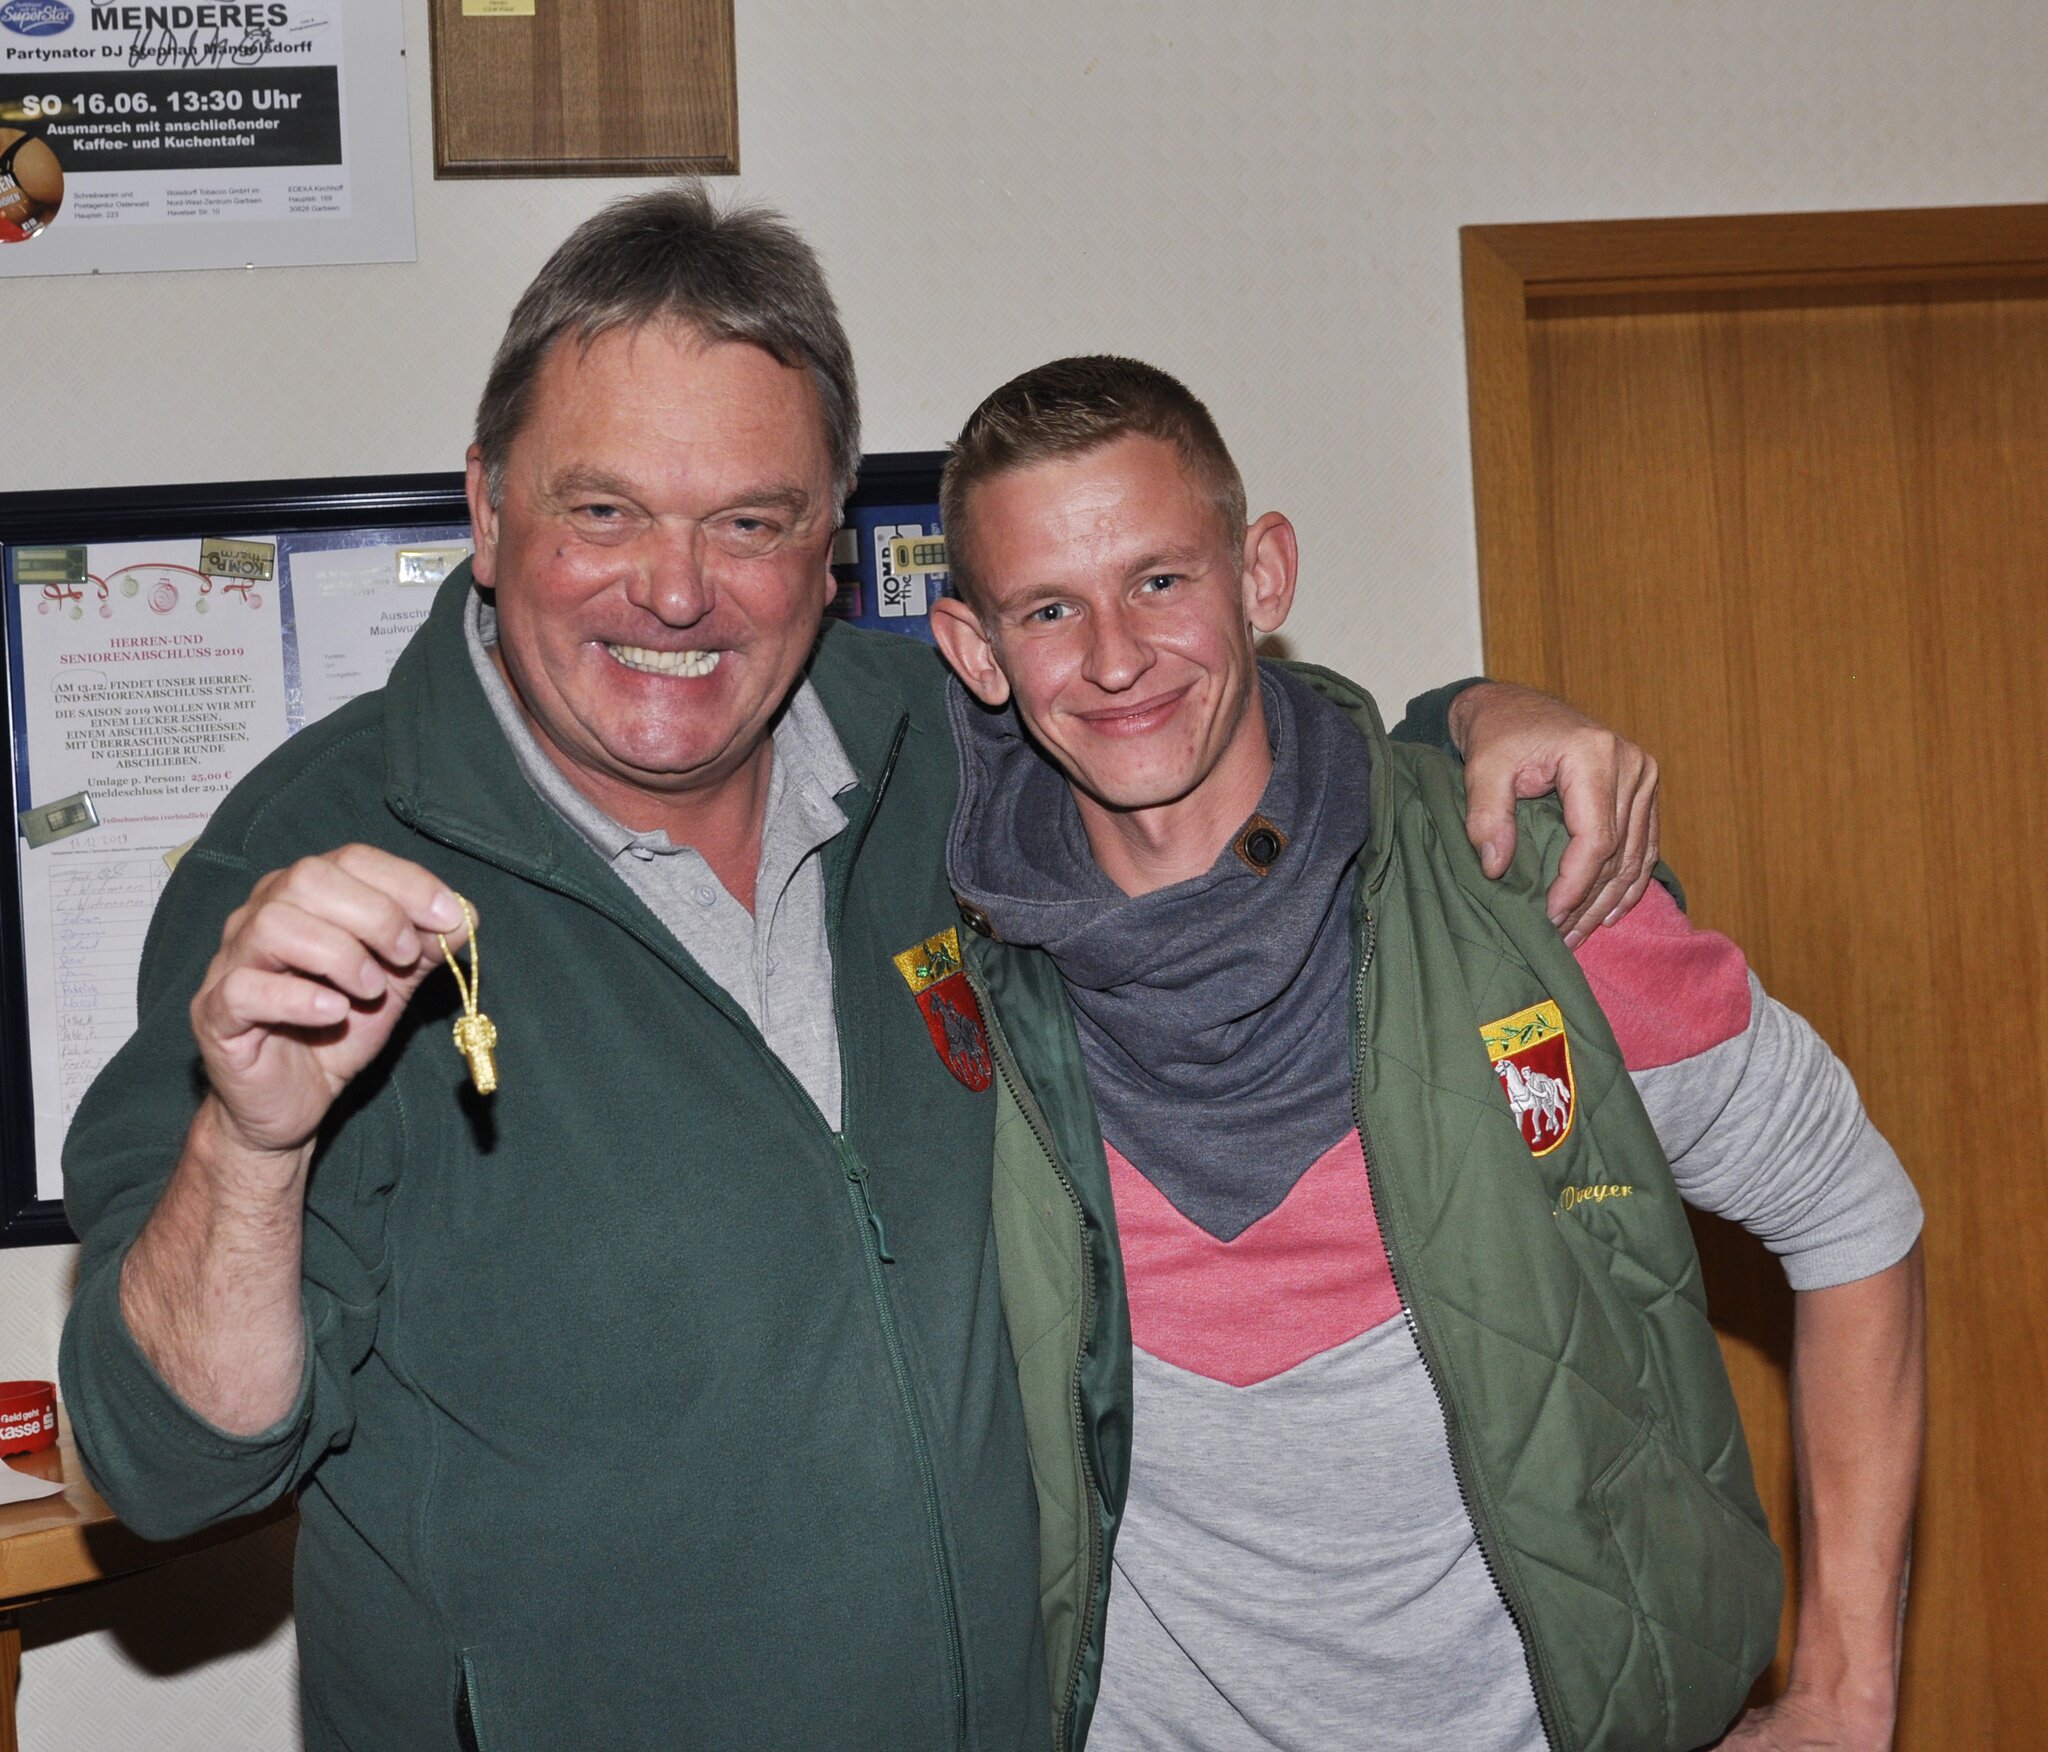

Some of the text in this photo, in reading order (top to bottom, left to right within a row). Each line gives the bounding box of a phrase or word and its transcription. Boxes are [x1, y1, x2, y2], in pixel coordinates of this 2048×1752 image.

[91, 3, 288, 30] MENDERES
[6, 40, 312, 62] Partynator DJ Stephan Mangelsdorff
[22, 89, 302, 116] SO 16.06. 13:30 Uhr
[46, 117, 280, 136] Ausmarsch mit anschließender
[73, 134, 255, 151] Kaffee- und Kuchentafel
[882, 536, 901, 606] KOMP
[370, 623, 421, 636] Maulwur
[110, 634, 203, 649] HERREN-UND
[59, 647, 245, 665] SENIORENABSCHLUSS 2019
[56, 684, 74, 693] AM
[110, 680, 153, 690] FINDET
[156, 677, 196, 687] UNSER
[199, 674, 252, 685] HERREN-
[54, 684, 255, 703] UND SENIORENABSCHLUSS STATT.
[55, 700, 256, 719] DIE SAISON 2019 WOLLEN WIR MIT
[91, 717, 129, 728] EINEM
[132, 714, 177, 725] LECKER
[67, 721, 247, 740] EINEM ABSCHLUSS-SCHIESSEN
[65, 741, 88, 751] MIT
[91, 744, 226, 759] IN GESELLIGER RUNDE
[88, 777, 129, 787] Umlage
[131, 777, 141, 787] p.
[144, 774, 185, 784] Person:
[224, 770, 232, 780] €
[91, 786, 164, 798] meldeschluss
[166, 785, 179, 795] ist
[181, 784, 201, 793] der
